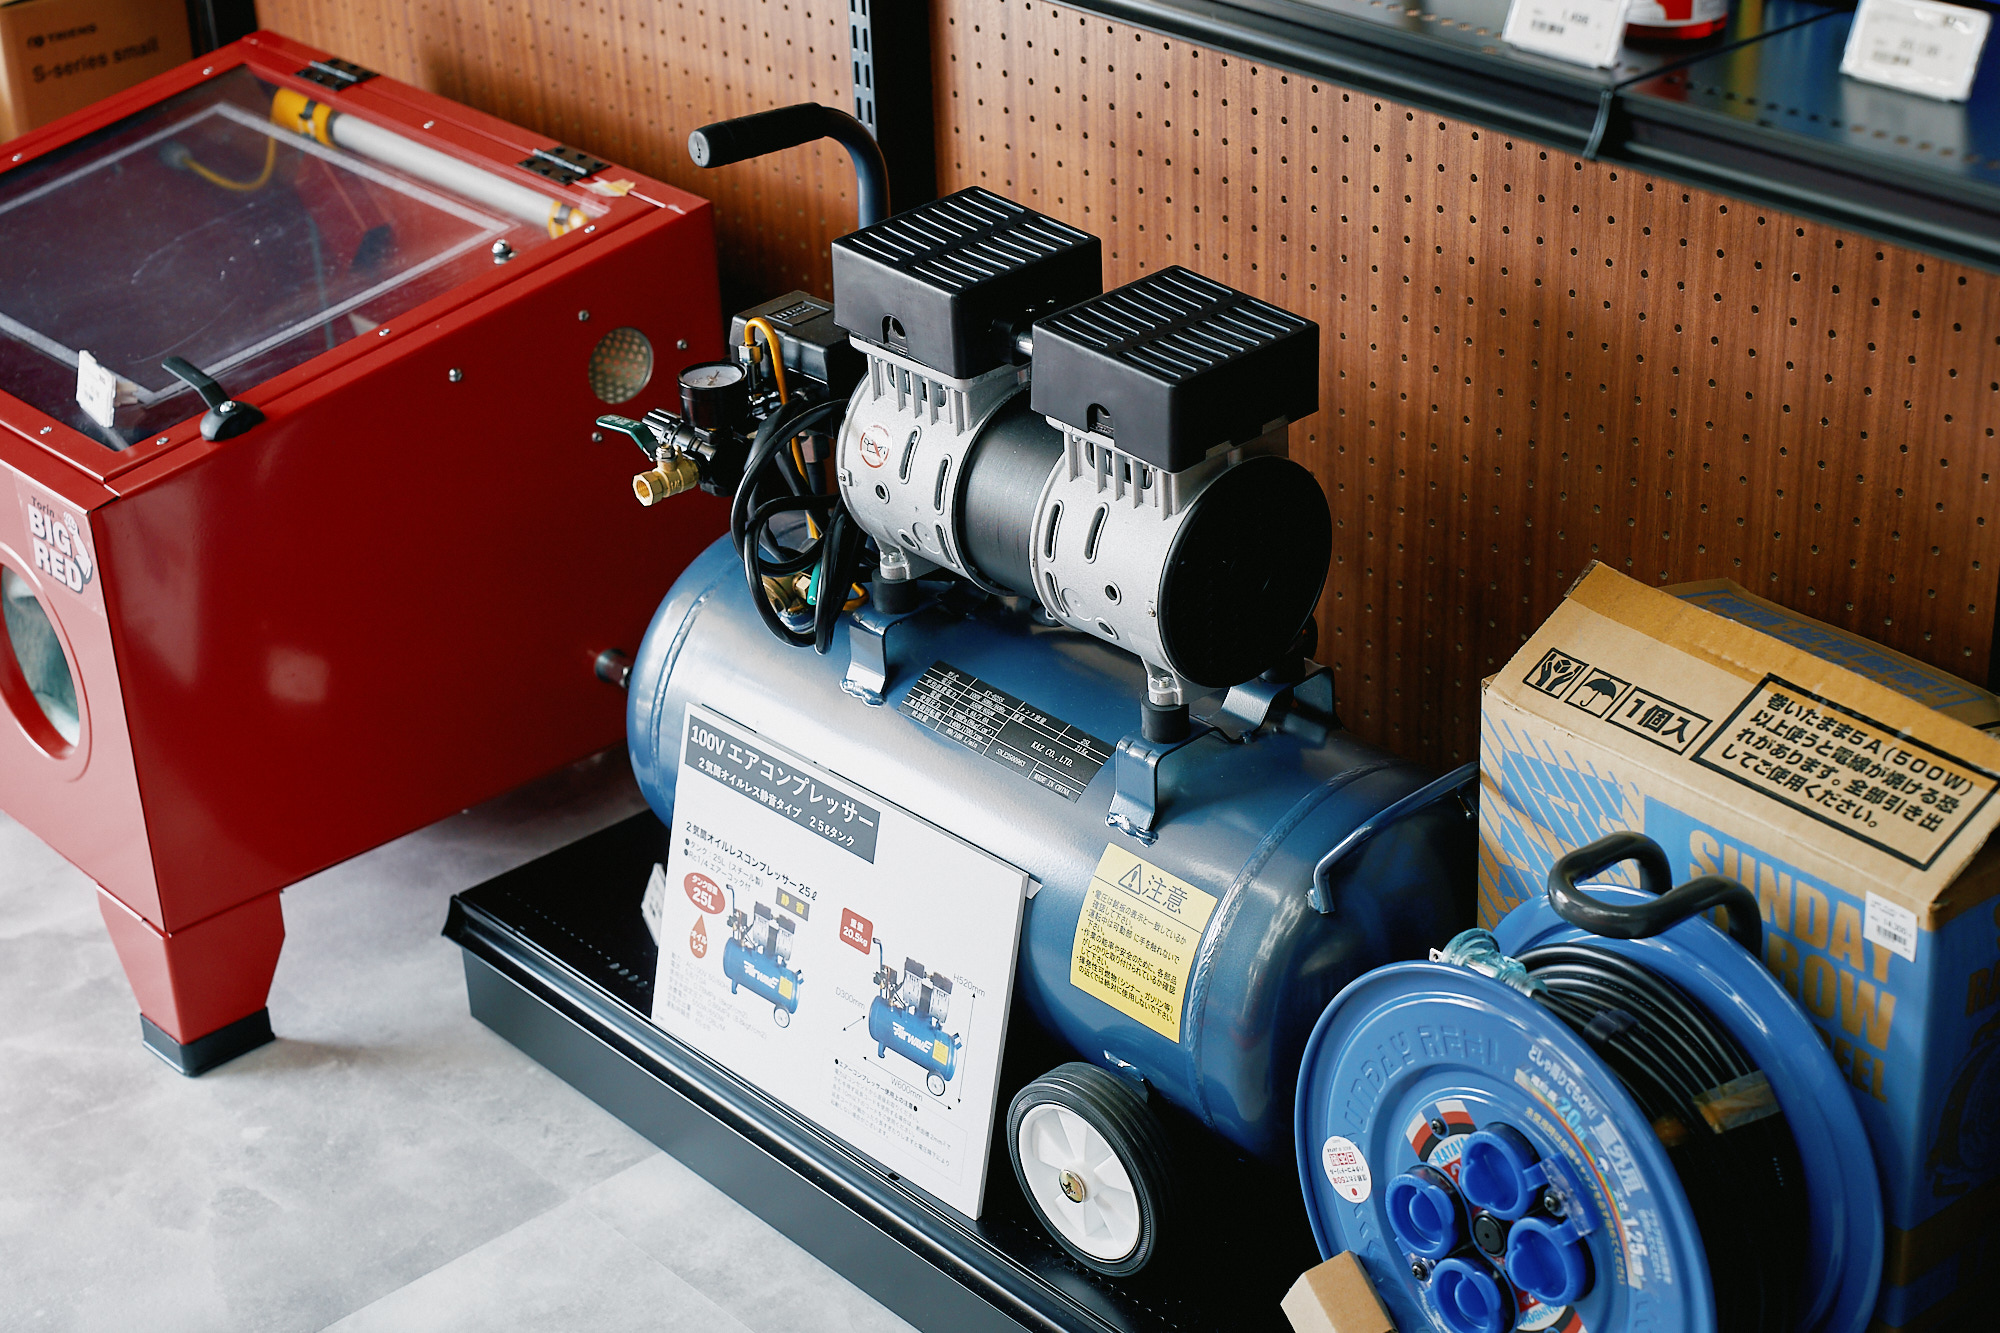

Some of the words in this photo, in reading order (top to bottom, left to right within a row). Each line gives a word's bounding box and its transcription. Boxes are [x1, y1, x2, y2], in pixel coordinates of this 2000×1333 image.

[32, 51, 108, 83] S-series
[113, 35, 158, 63] small
[31, 496, 55, 518] Torin
[28, 504, 72, 557] BIG
[33, 537, 83, 594] RED
[1626, 698, 1691, 744] 1個入
[1031, 741, 1045, 753] KAZ
[1749, 709, 1959, 815] 以上使うと電線が焼ける恐
[690, 725, 725, 755] 100V
[727, 743, 874, 828] エアコンプレッサー
[1034, 772, 1048, 784] MADE
[1047, 778, 1054, 788] IN
[1055, 783, 1071, 797] CHINA
[1721, 743, 1878, 829] してご使用ください。
[1736, 727, 1944, 833] れがあります。全部引き出
[693, 887, 715, 911] 25L
[1142, 874, 1188, 914] 注意
[842, 926, 868, 948] 20.5kg
[1087, 918, 1105, 936] 下さい。
[1079, 946, 1110, 969] して下さい。
[835, 986, 866, 1010] D300mm
[953, 973, 986, 998] H520mm
[891, 1077, 923, 1101] W600mm
